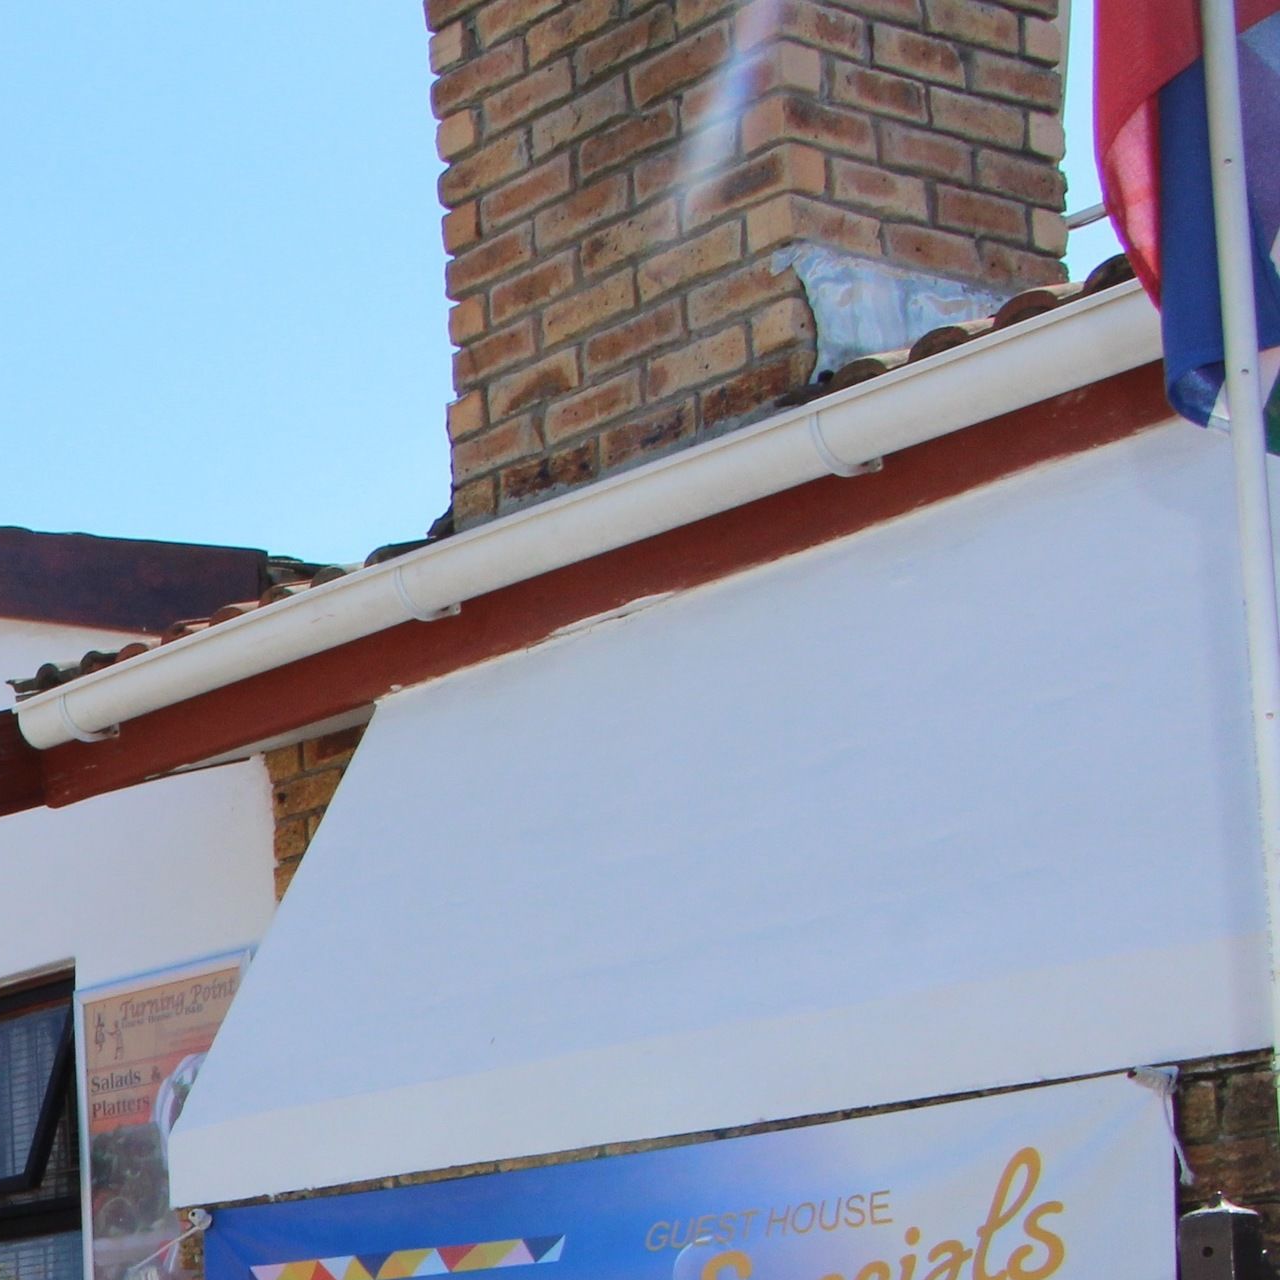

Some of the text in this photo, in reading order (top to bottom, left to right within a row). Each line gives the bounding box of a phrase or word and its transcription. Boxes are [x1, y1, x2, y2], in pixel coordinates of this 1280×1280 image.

[91, 1069, 141, 1093] Salads
[92, 1096, 150, 1118] Platters
[645, 1190, 894, 1253] GUEST HOUSE
